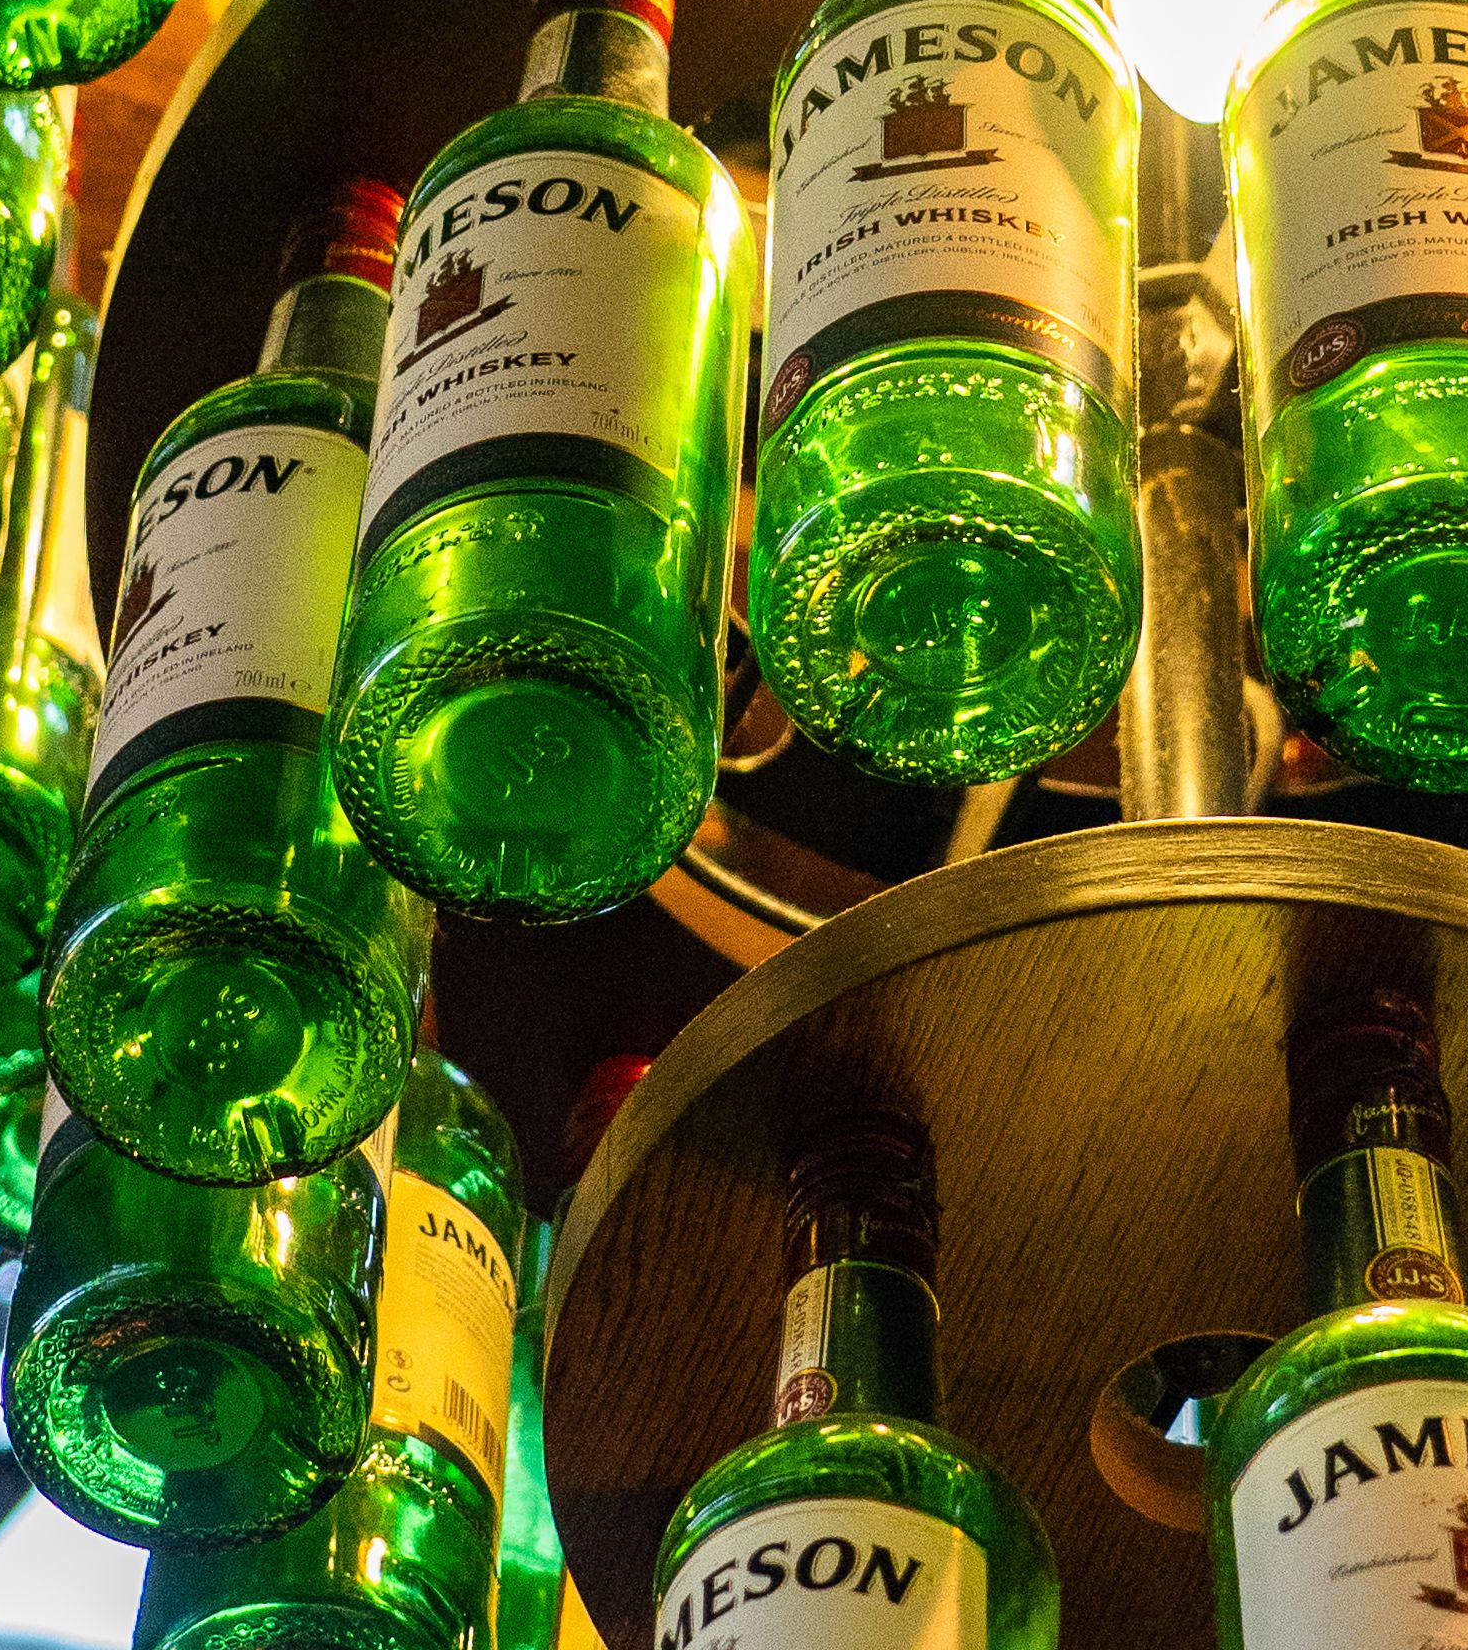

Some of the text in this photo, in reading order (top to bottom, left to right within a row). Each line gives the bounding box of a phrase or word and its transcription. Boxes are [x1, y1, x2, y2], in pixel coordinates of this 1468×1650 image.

[776, 22, 1101, 183] JAMESON
[795, 206, 1067, 284] IRISH WHISKEY
[1324, 209, 1429, 249] IRISH
[416, 351, 578, 406] WHISKEY
